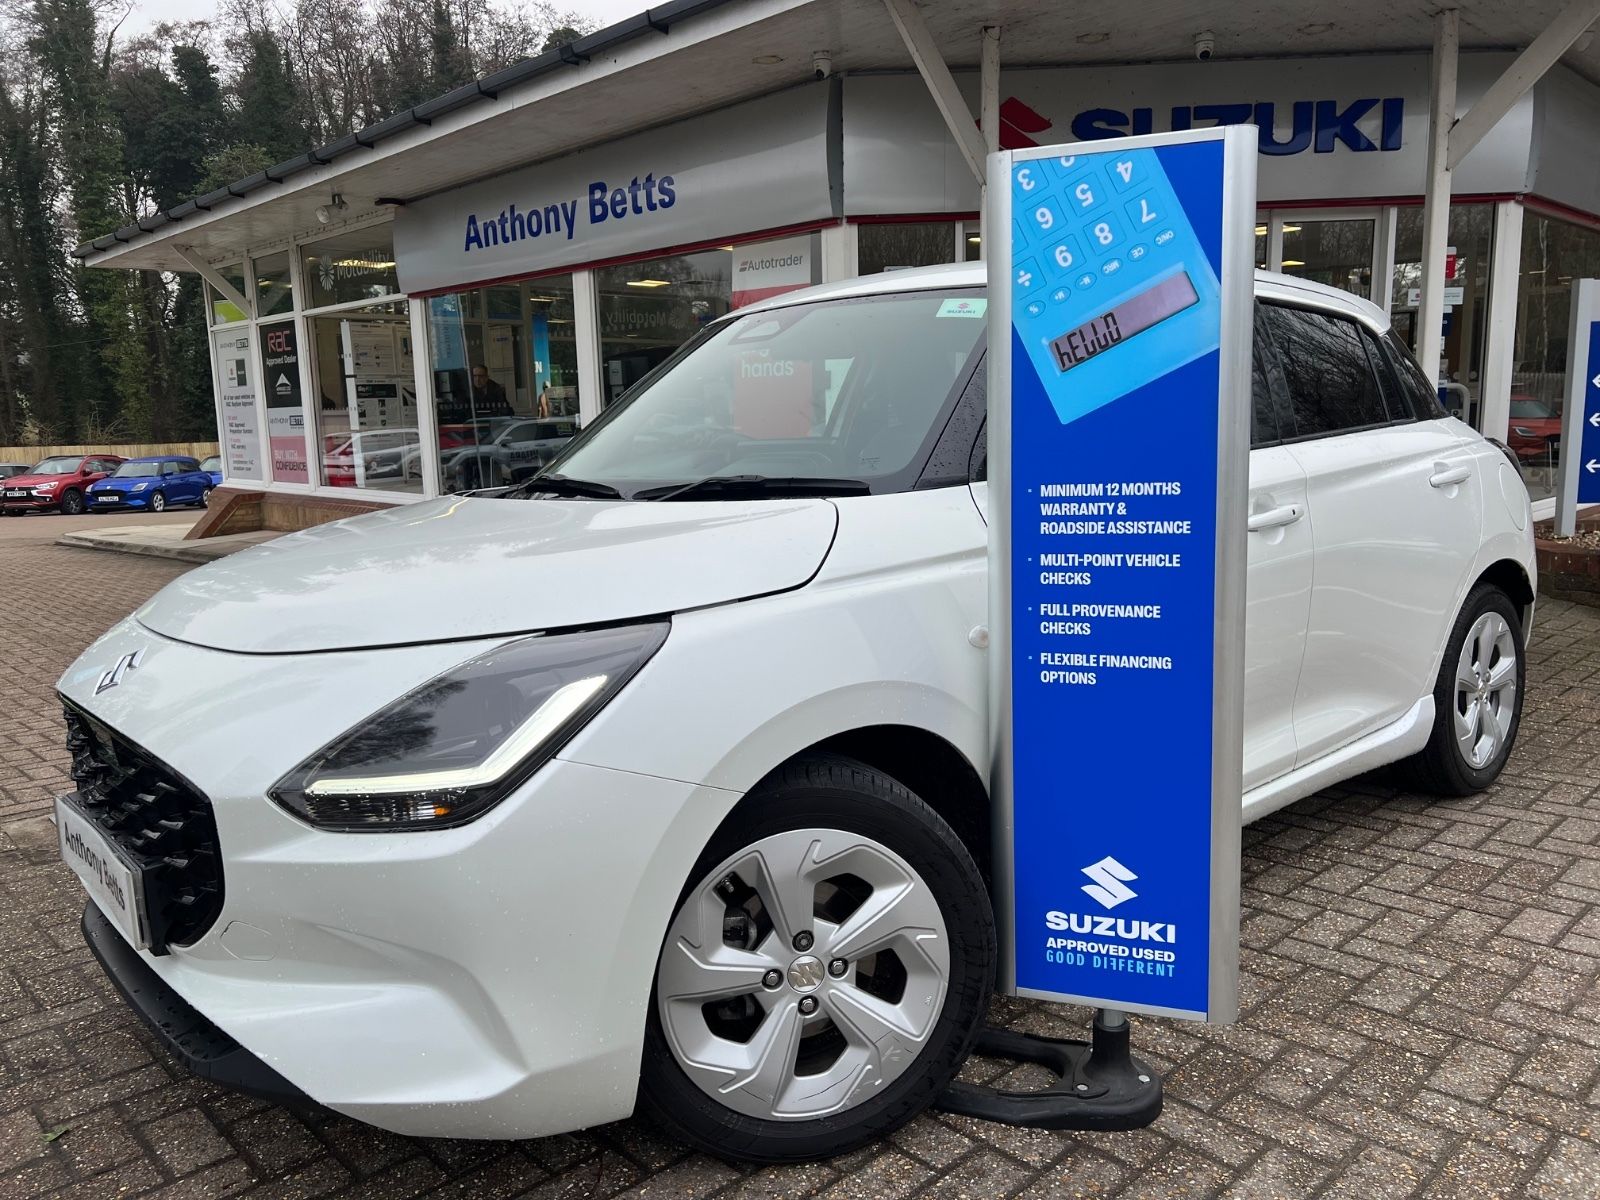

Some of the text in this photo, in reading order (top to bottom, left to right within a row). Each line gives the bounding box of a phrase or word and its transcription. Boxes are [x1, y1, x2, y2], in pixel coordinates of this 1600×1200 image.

[1017, 169, 1035, 191] 3
[1116, 160, 1133, 183] 4
[1075, 183, 1094, 208] 5
[465, 173, 676, 251] Anthony Betts
[1035, 207, 1054, 229] 6
[1140, 199, 1156, 223] 7
[1094, 222, 1113, 245] 8
[748, 254, 803, 272] Autotrader
[1054, 245, 1073, 267] 9
[1132, 247, 1145, 258] CE
[336, 249, 391, 281] Motability
[741, 360, 794, 378] hands
[1040, 482, 1181, 497] MINIMUM 12 MONTHS
[1040, 502, 1127, 515] WARRANTY &
[1040, 521, 1191, 534] ROADSIDE ASSISTANCE
[1040, 554, 1180, 567] MULTI-POINT VEHICLE
[1040, 572, 1091, 585] CHECKS
[1040, 604, 1161, 618] FULL PROVENANCE
[1040, 622, 1091, 635] CHECKS
[1040, 653, 1172, 670] FLEXIBLE FINANCING
[1040, 671, 1097, 685] OPTIONS
[64, 822, 126, 911] Anthony Betts
[1045, 910, 1176, 944] SUZUKI
[1046, 937, 1176, 963] APPROVED USED
[1046, 950, 1175, 977] GOOD DIFFERENT
